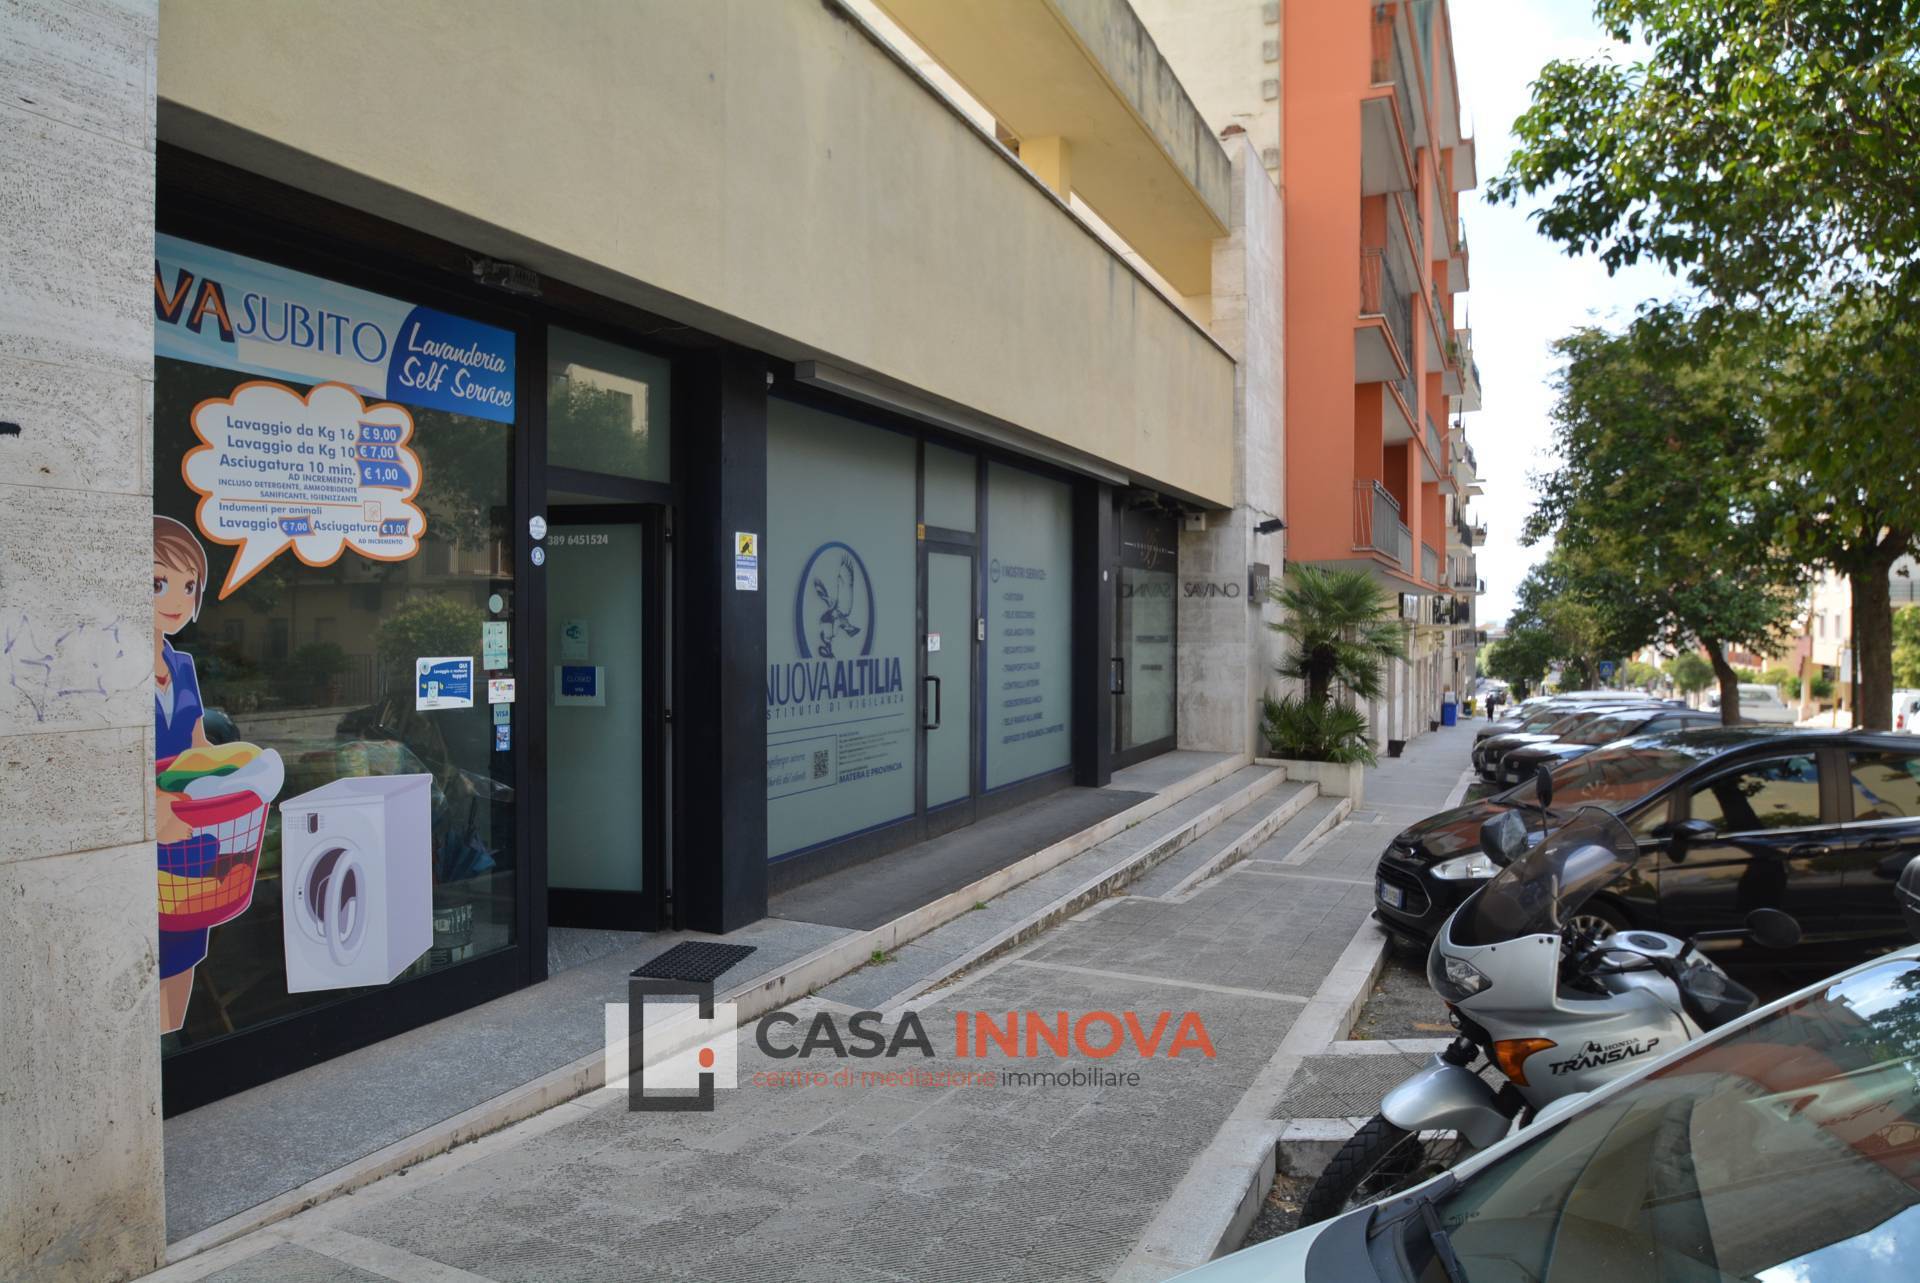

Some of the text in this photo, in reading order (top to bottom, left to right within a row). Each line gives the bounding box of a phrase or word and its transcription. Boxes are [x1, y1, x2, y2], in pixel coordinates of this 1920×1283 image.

[408, 322, 506, 373] Lavanderia
[399, 358, 513, 408] Self Service
[226, 415, 292, 436] Lavaggio
[296, 424, 314, 437] da
[318, 426, 335, 441] Kg
[340, 428, 355, 441] 16
[372, 428, 397, 442] 9,00
[227, 435, 293, 456] Lavaggio
[297, 443, 315, 456] da
[319, 445, 336, 459] Kg
[341, 446, 356, 459] 10
[370, 446, 394, 459] 7,00
[219, 454, 357, 477] Asciugatura 10 min.
[218, 479, 252, 488] INCLUSO
[288, 472, 354, 485] AD INCREMENTO
[374, 468, 398, 482] 1,00
[218, 502, 323, 516] Indumenti per animali
[219, 516, 278, 531] Lavaggio
[313, 519, 378, 534] Asciugatura
[548, 535, 565, 546] 389
[1184, 582, 1240, 599] SAVINO
[1604, 1037, 1640, 1052] HONDA
[1548, 1037, 1660, 1075] TRANSALP
